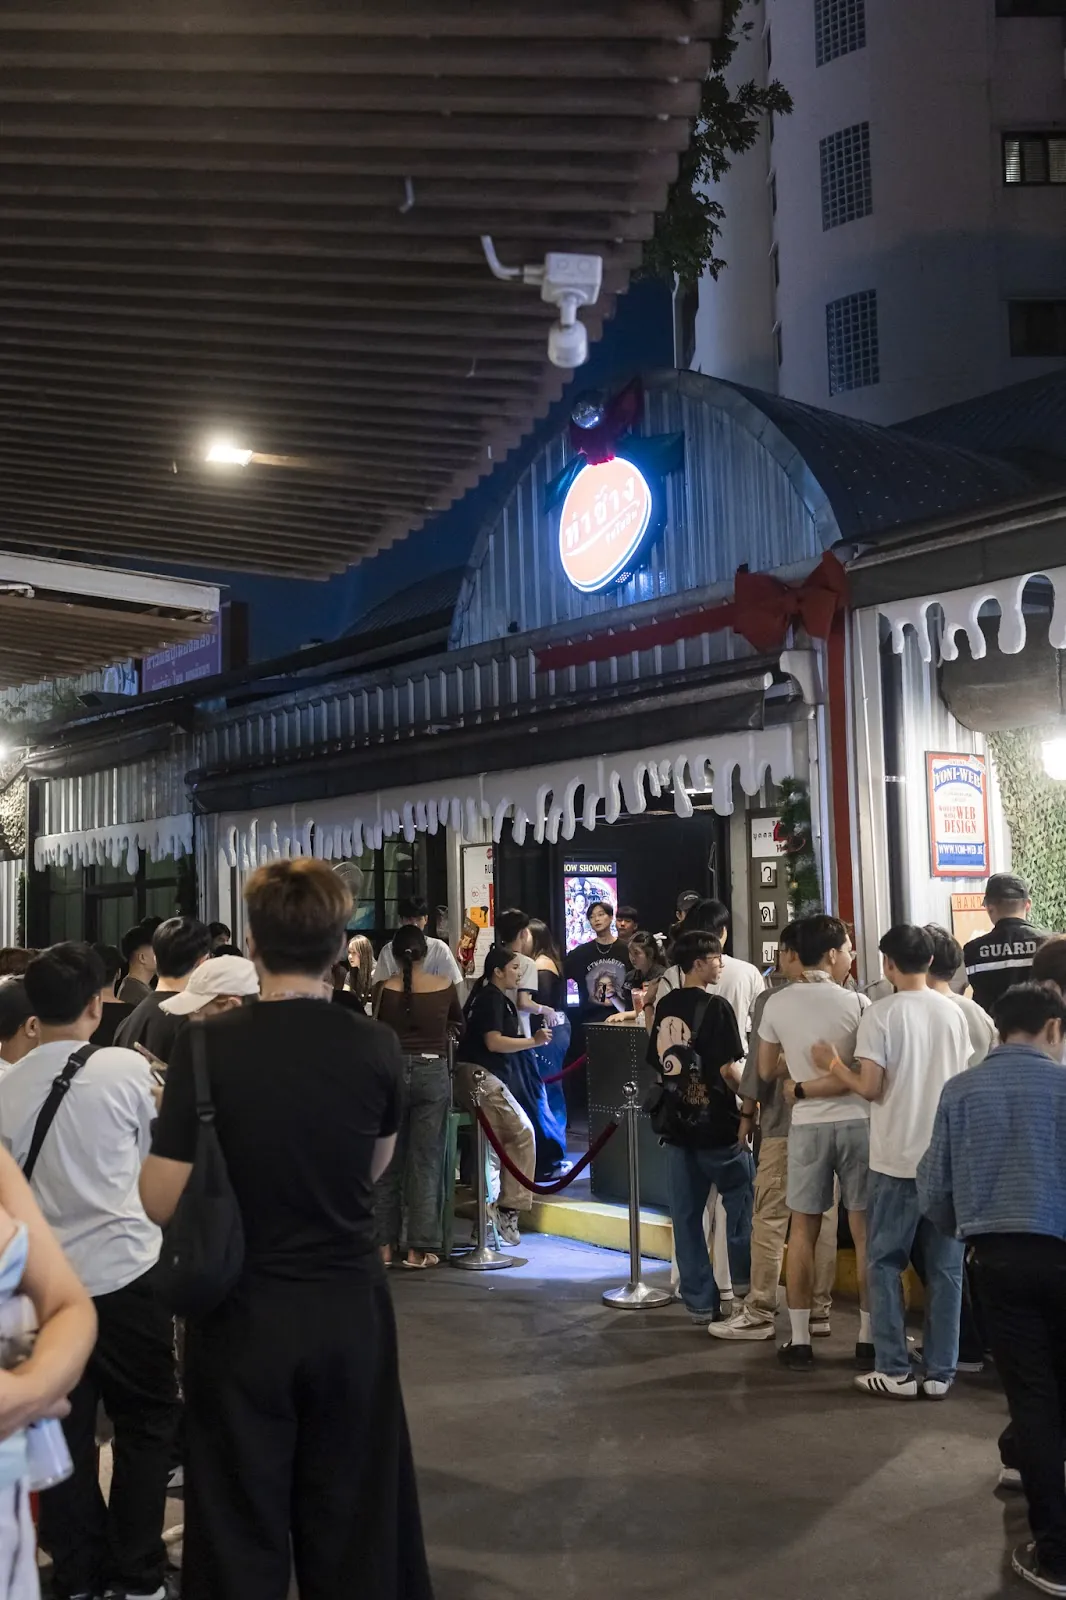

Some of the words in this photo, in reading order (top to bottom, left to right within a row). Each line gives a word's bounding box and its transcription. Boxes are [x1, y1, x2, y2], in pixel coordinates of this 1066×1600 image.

[564, 477, 635, 549] ท่าช้าง
[956, 806, 976, 820] WEB
[944, 819, 977, 834] DESIGN
[579, 863, 612, 873] SHOWING
[979, 941, 1037, 958] GUARD
